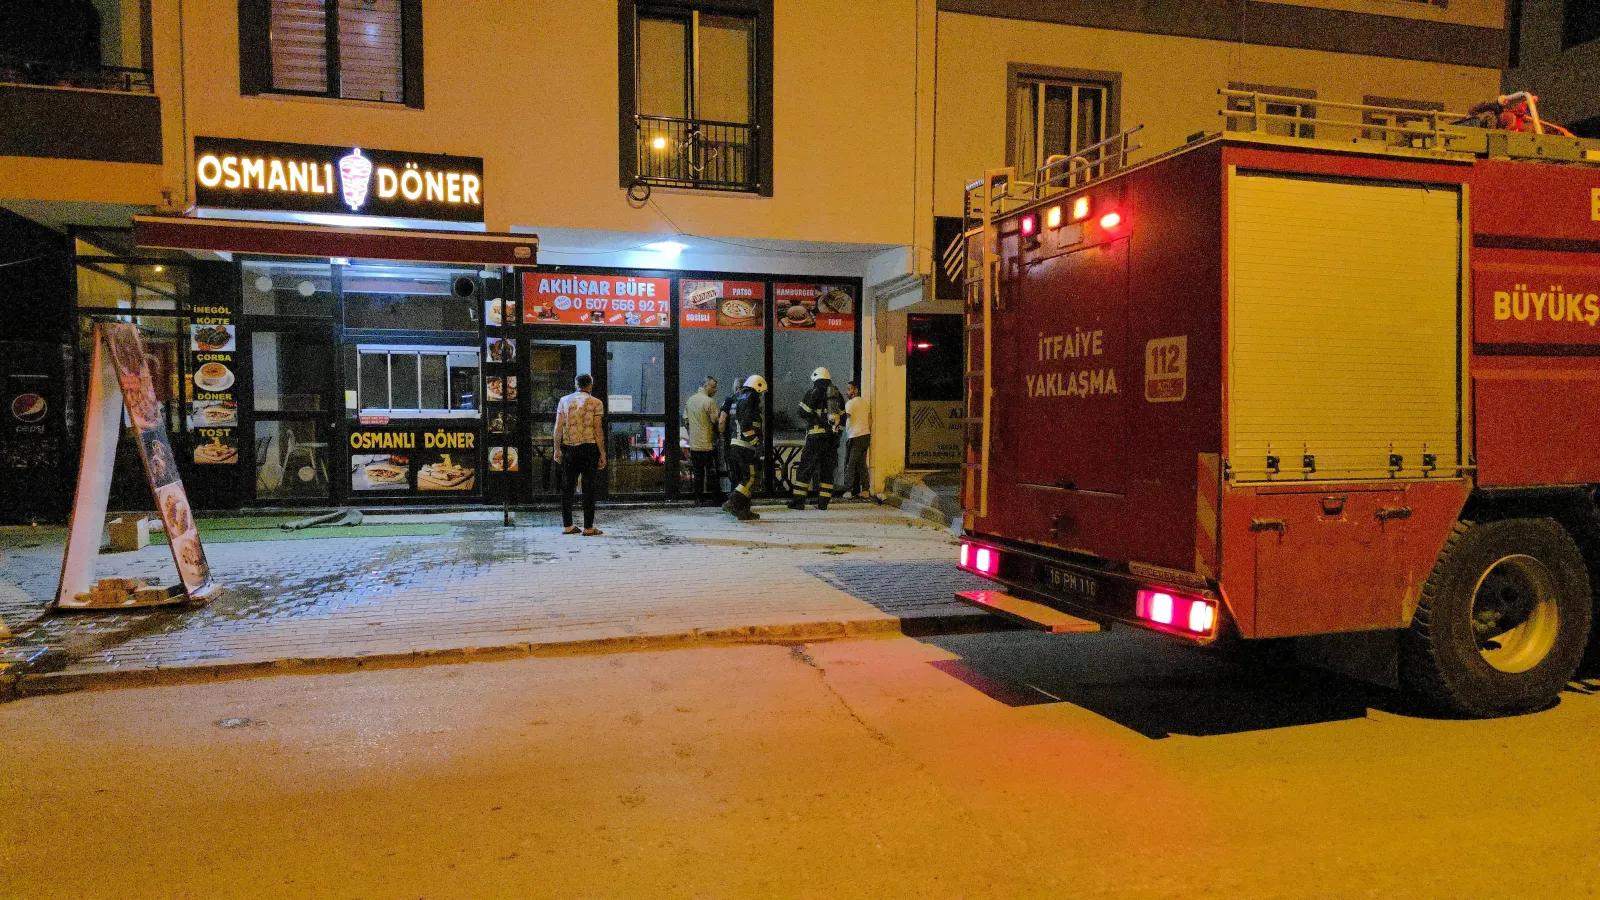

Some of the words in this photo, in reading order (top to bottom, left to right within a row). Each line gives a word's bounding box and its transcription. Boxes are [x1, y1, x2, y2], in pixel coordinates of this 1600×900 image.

[198, 155, 333, 194] OSMANLI
[377, 163, 480, 204] DÖNER
[538, 276, 610, 295] AKHİSAR
[615, 278, 655, 297] BÜFE
[732, 288, 752, 296] PATSO
[776, 288, 814, 297] HAMBURGER
[193, 305, 231, 314] İNEGÖL
[573, 298, 582, 310] 0
[585, 298, 608, 310] 507
[611, 299, 635, 311] 556
[638, 300, 655, 311] 92
[658, 301, 668, 312] 71
[1494, 284, 1600, 326] BÜYÜKŞ
[828, 318, 842, 326] TOST
[1038, 326, 1104, 361] İTFAİYE
[1151, 344, 1180, 374] 112
[1025, 368, 1118, 399] YAKLAŞMA
[197, 392, 232, 400] DÖNER
[199, 428, 232, 437] TOST
[350, 432, 415, 449] OSMANLI
[424, 429, 474, 448] DÖNER
